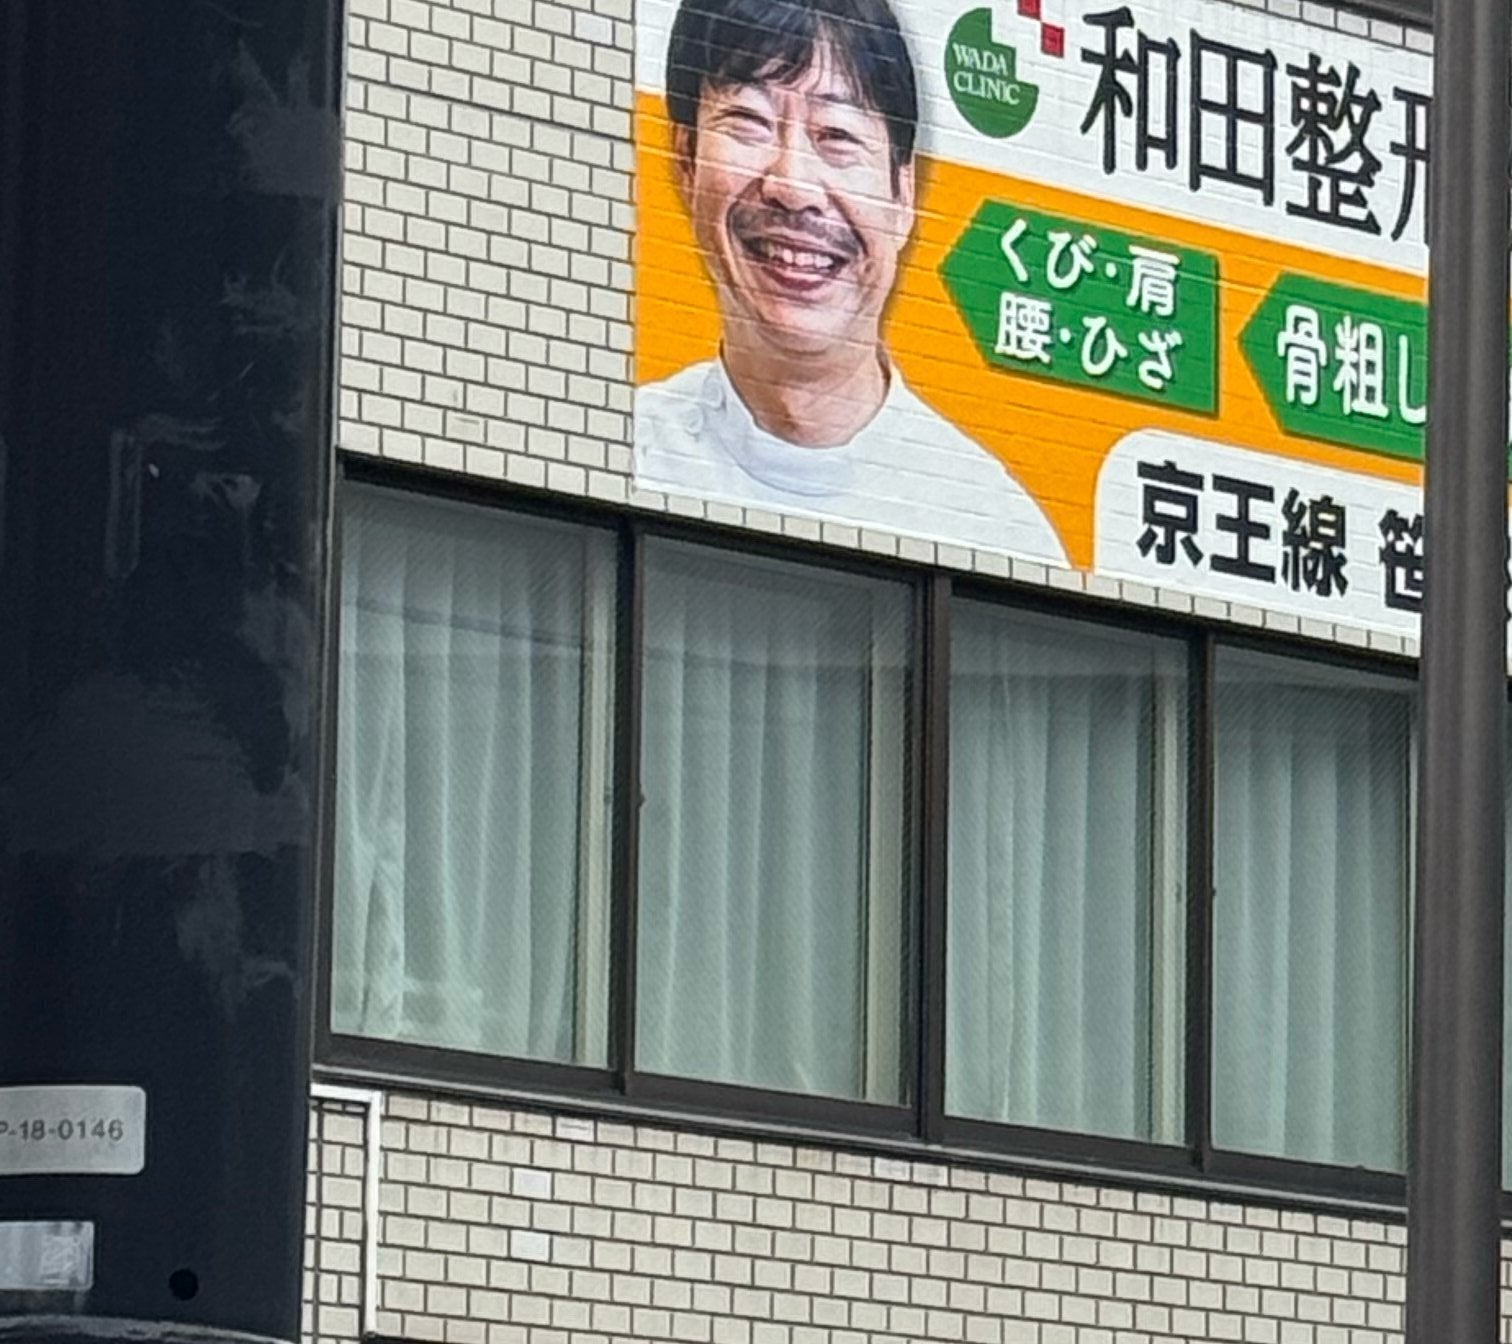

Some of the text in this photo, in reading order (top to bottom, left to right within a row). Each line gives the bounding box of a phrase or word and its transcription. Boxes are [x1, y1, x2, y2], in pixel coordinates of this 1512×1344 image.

[952, 42, 1009, 73] WADA
[952, 71, 1022, 107] CLINIC
[1135, 460, 1349, 600] 京王線
